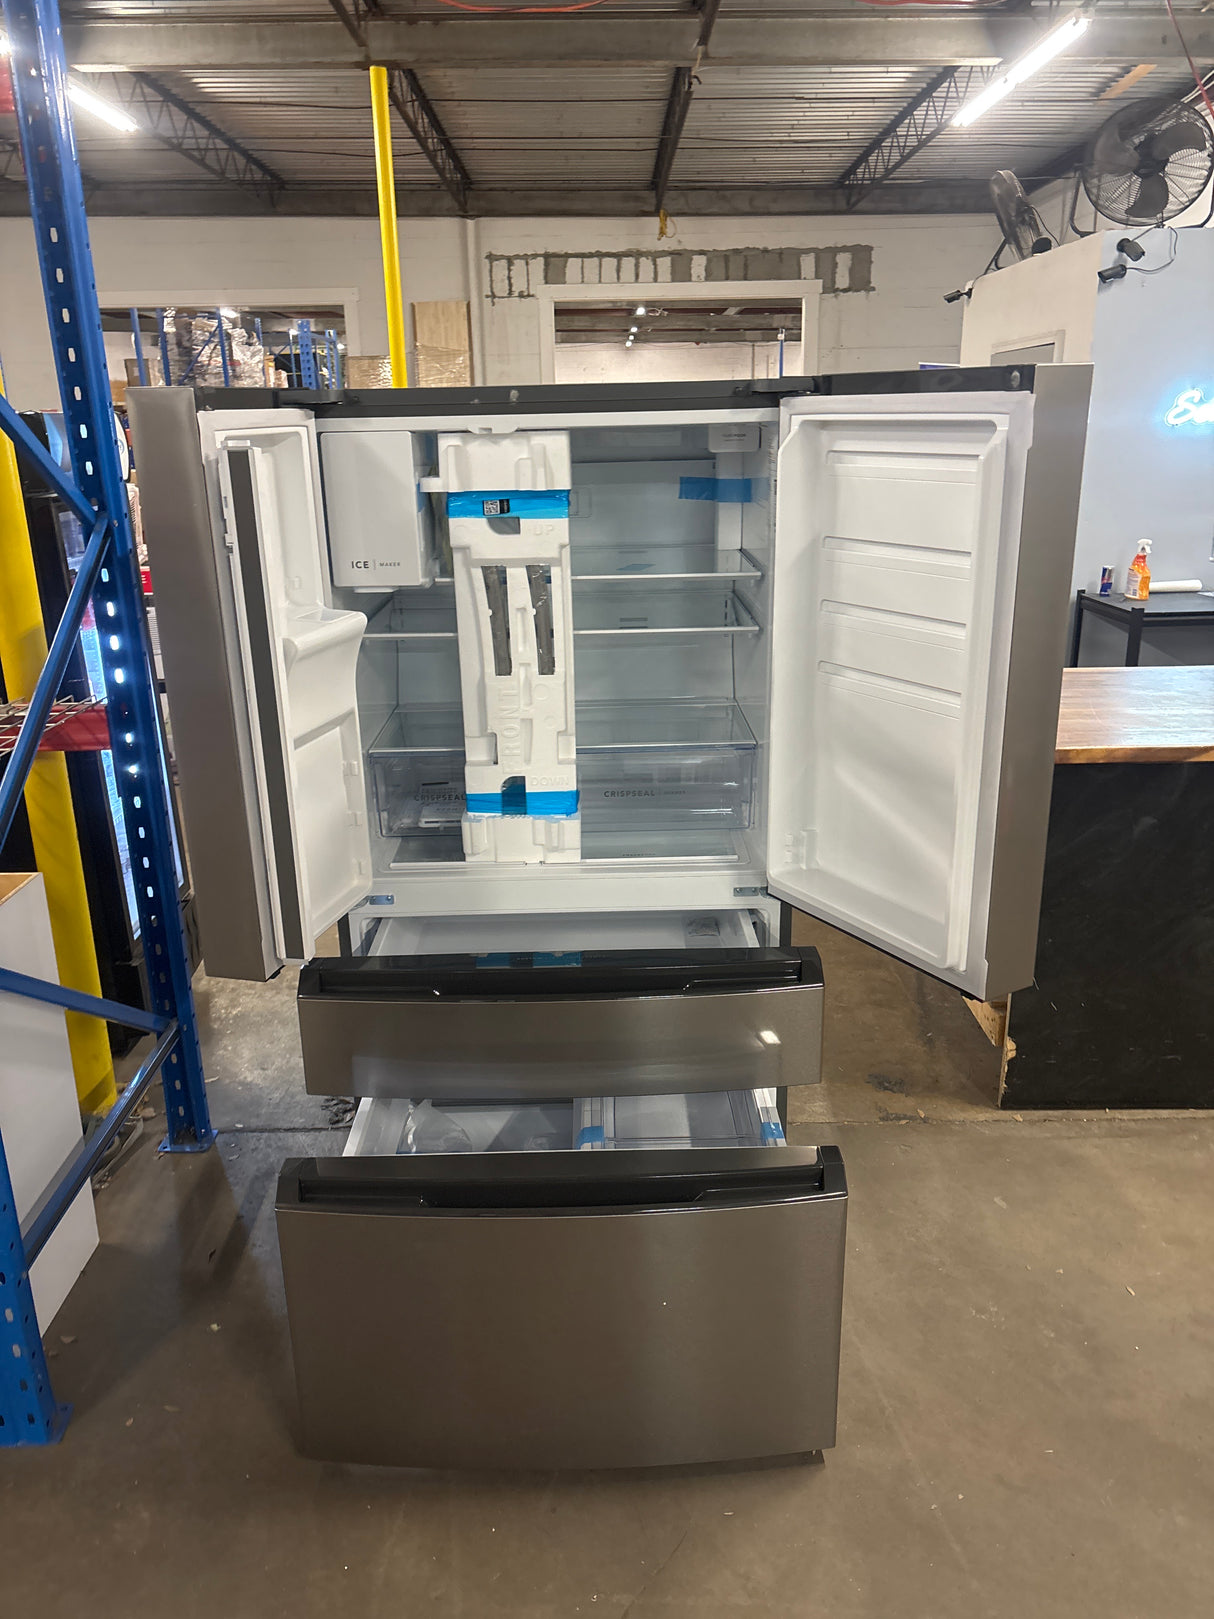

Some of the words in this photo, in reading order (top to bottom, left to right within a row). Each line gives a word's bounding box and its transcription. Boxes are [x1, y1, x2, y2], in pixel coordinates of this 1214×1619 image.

[351, 560, 370, 569] ICE
[497, 687, 522, 775] FRONT
[530, 776, 569, 787] DOWN
[414, 794, 466, 802] CRISPSEAL
[603, 790, 656, 798] CRISPSEAL
